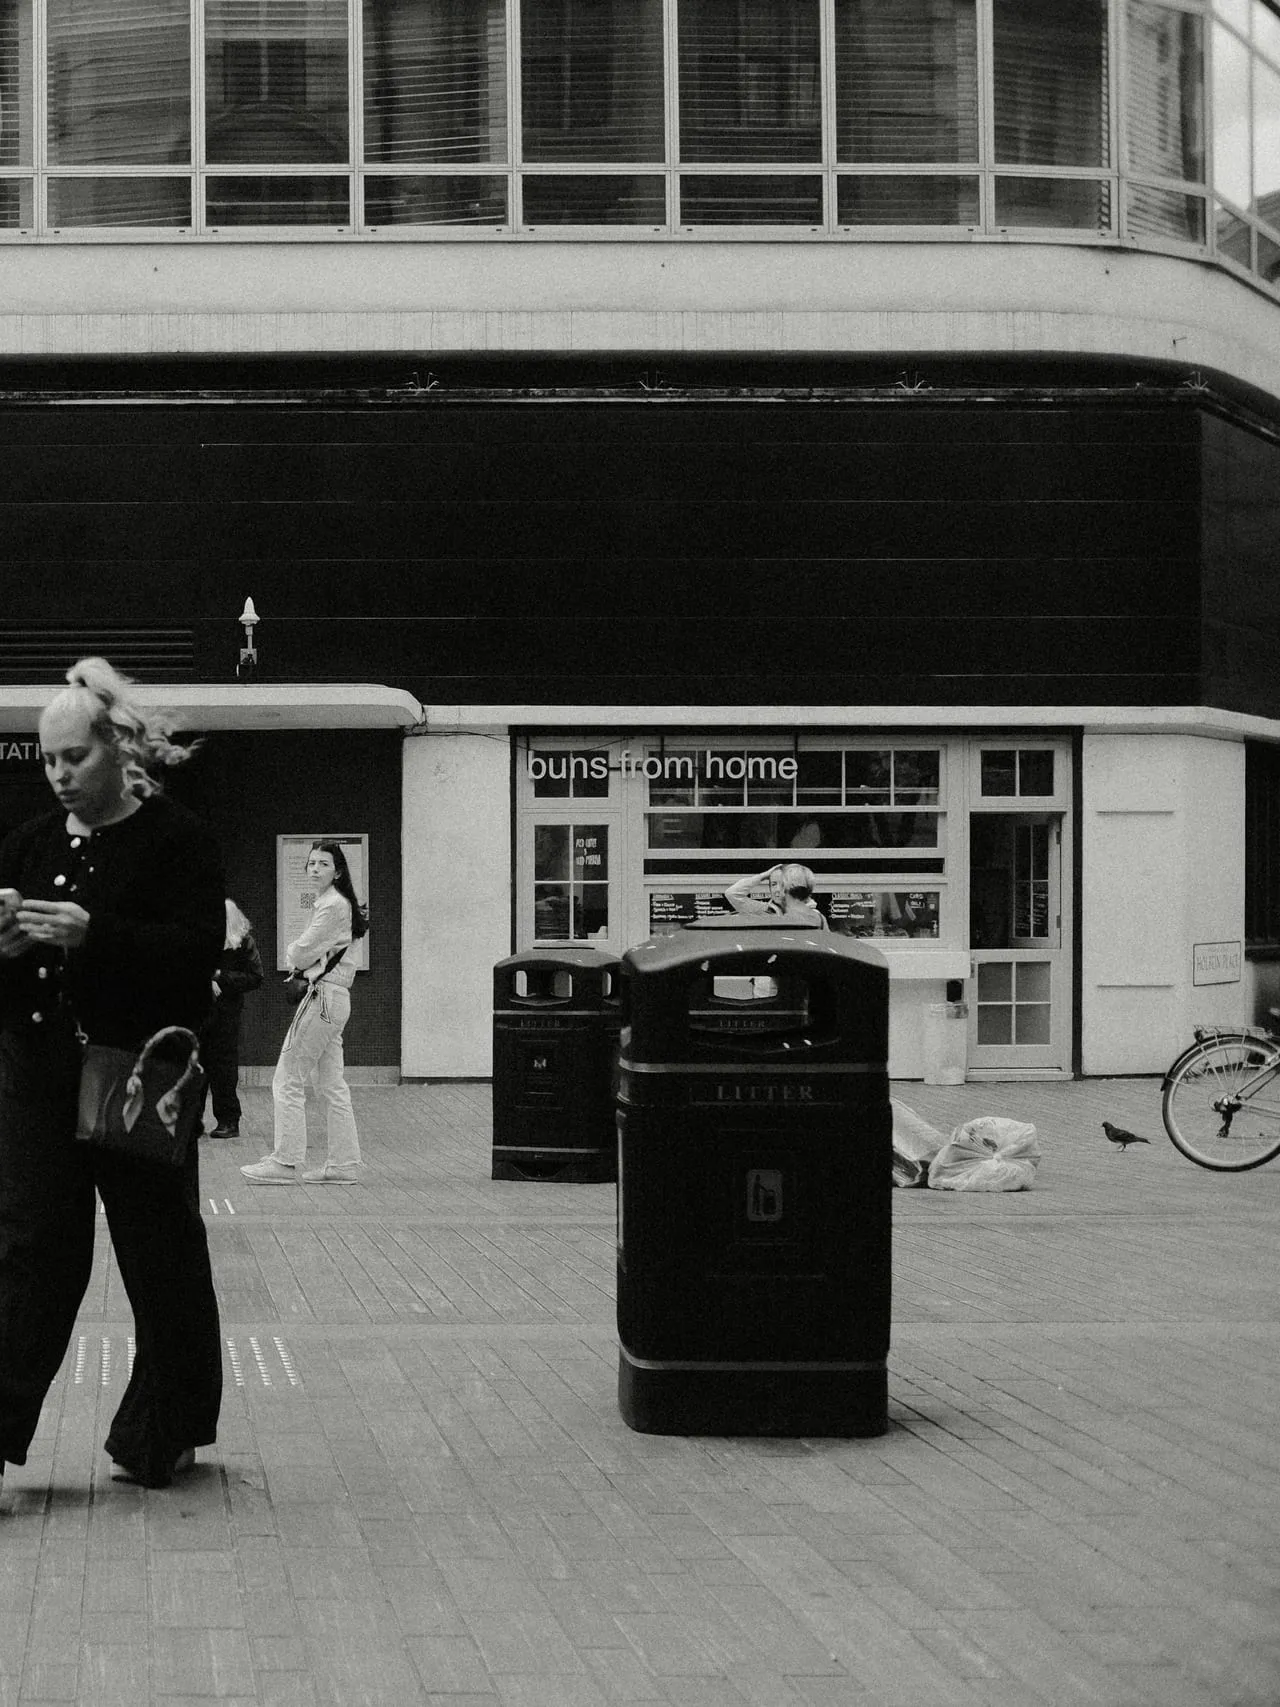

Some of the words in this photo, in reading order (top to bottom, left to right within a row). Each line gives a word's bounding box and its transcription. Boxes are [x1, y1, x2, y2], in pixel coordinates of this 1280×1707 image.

[527, 750, 608, 780] buns
[620, 750, 693, 780] from
[706, 750, 798, 780] home
[719, 1019, 766, 1028] LITTER
[717, 1085, 814, 1101] LITTER
